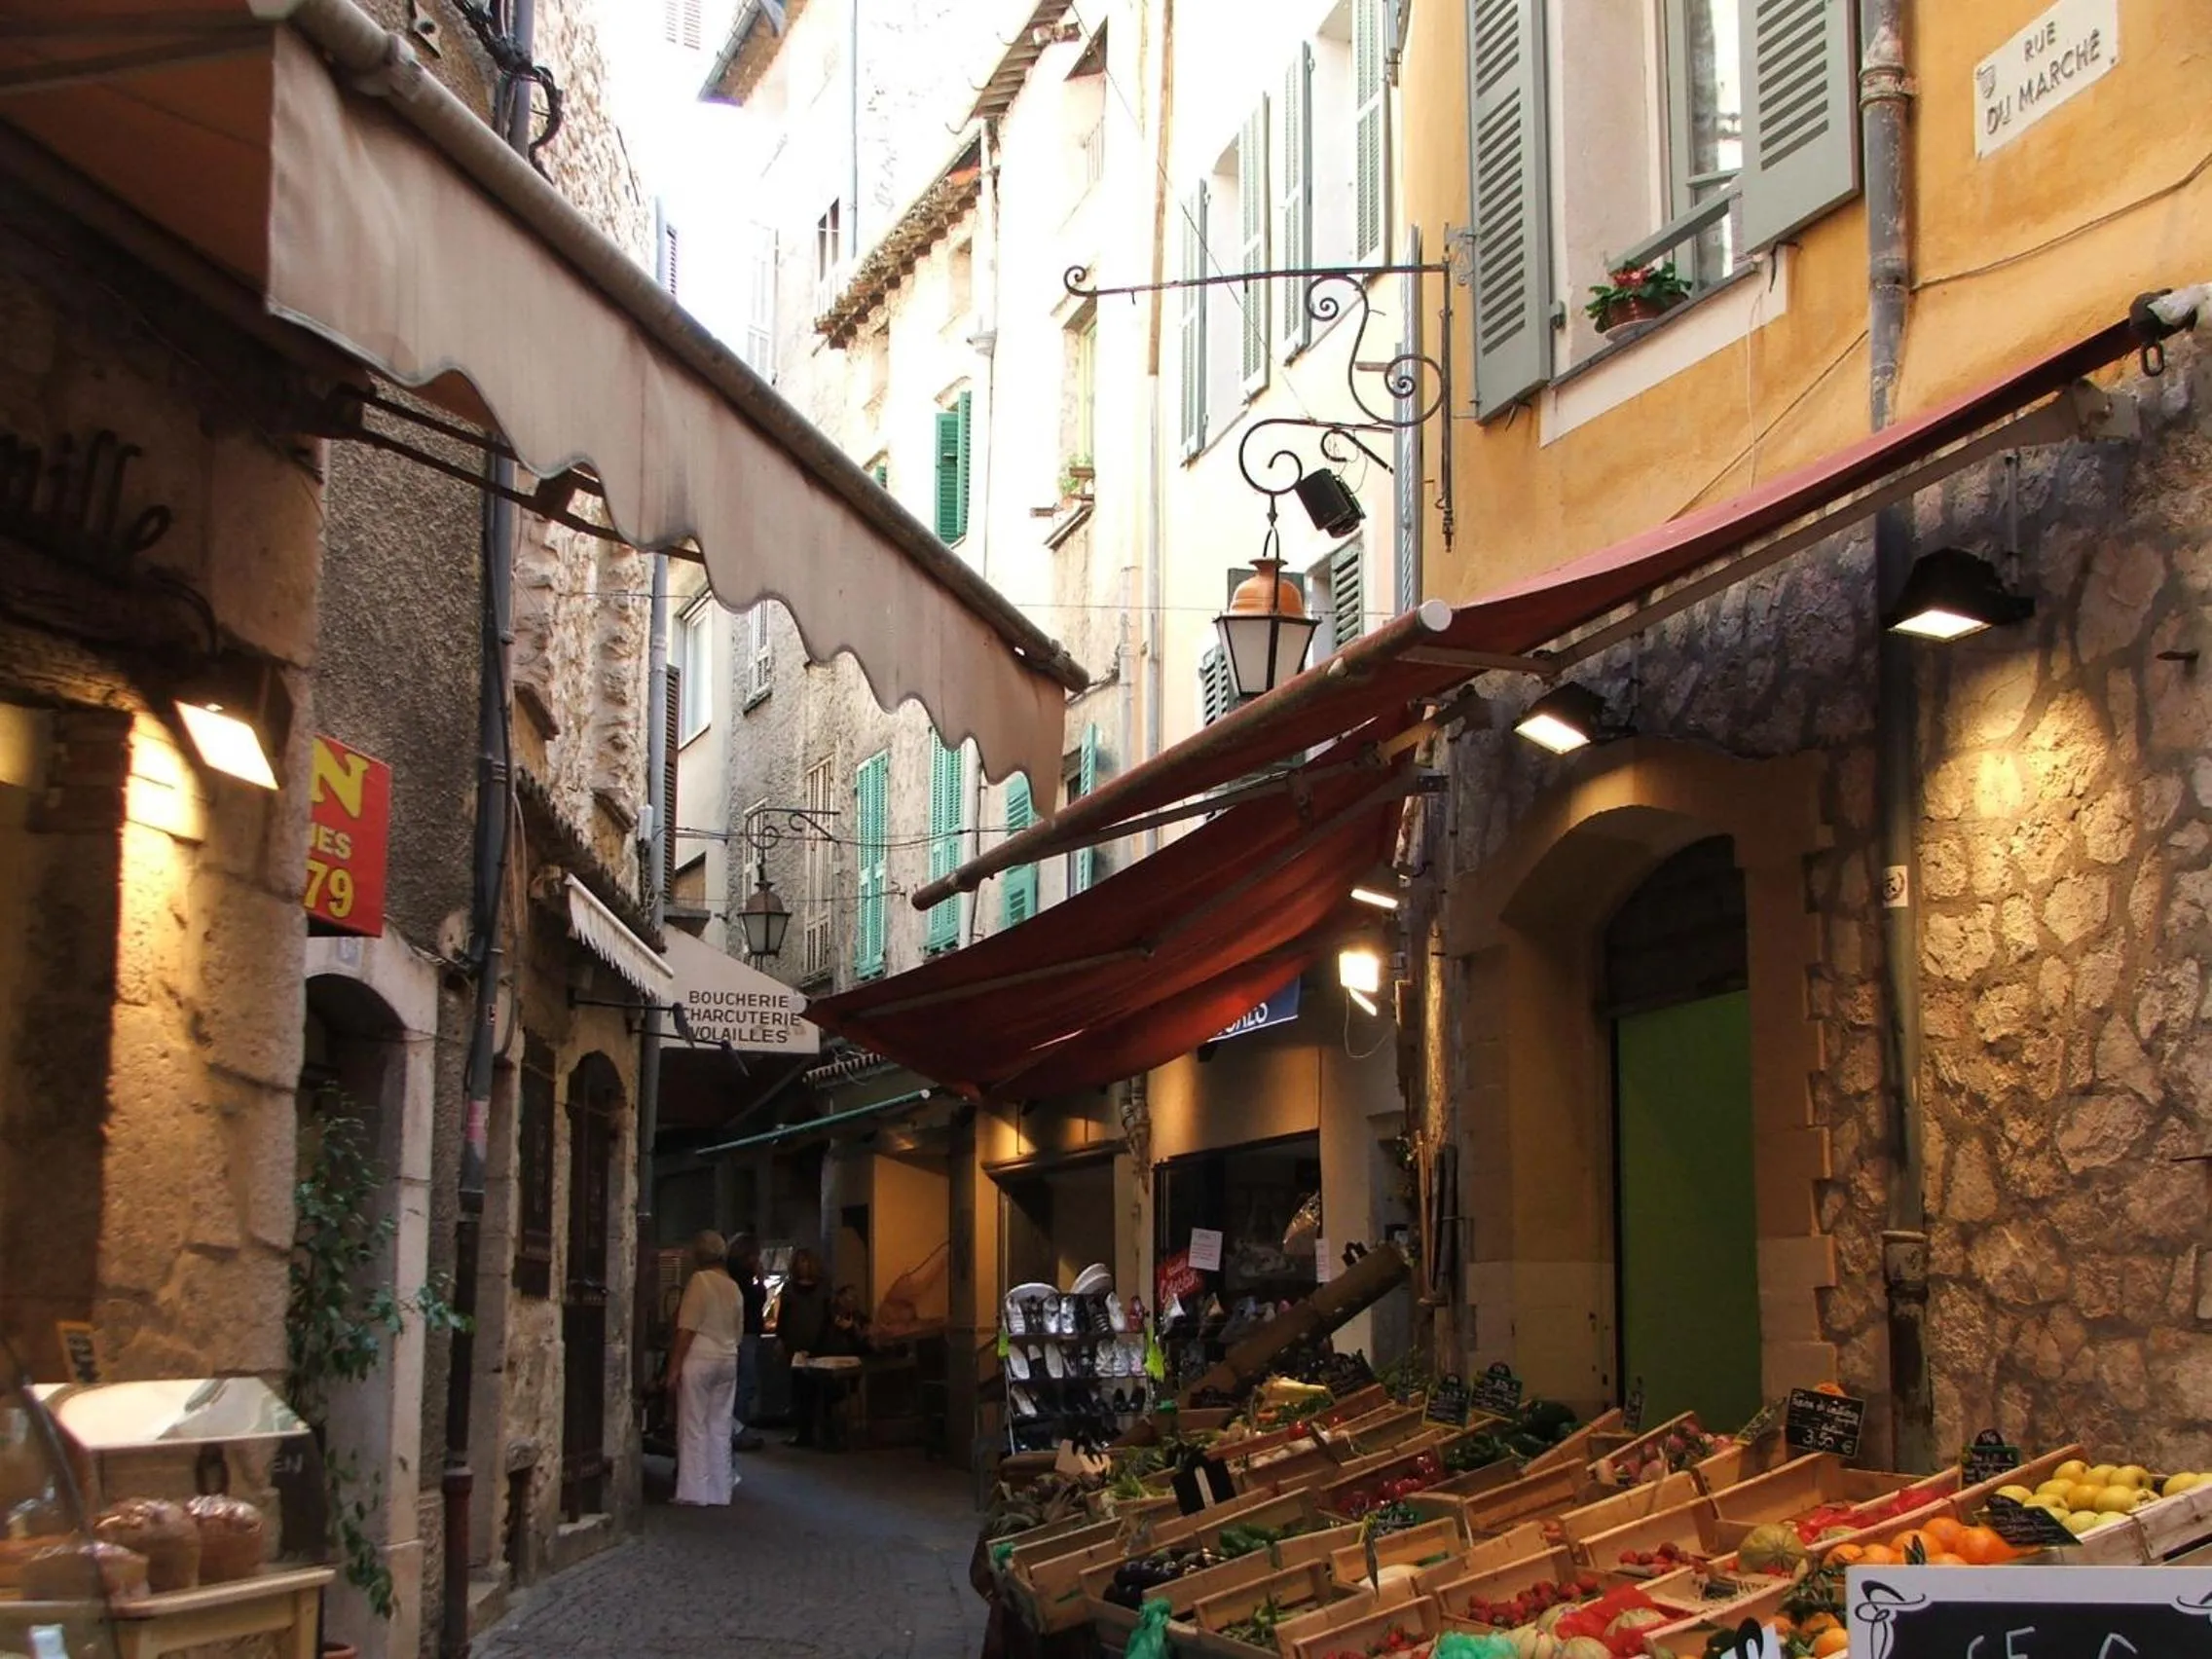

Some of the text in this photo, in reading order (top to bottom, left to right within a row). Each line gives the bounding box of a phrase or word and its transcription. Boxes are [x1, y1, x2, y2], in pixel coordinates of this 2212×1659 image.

[2024, 20, 2056, 61] RUE
[1986, 94, 2011, 135] DU
[304, 858, 354, 918] 79
[688, 990, 790, 1009] BOUCHERIE
